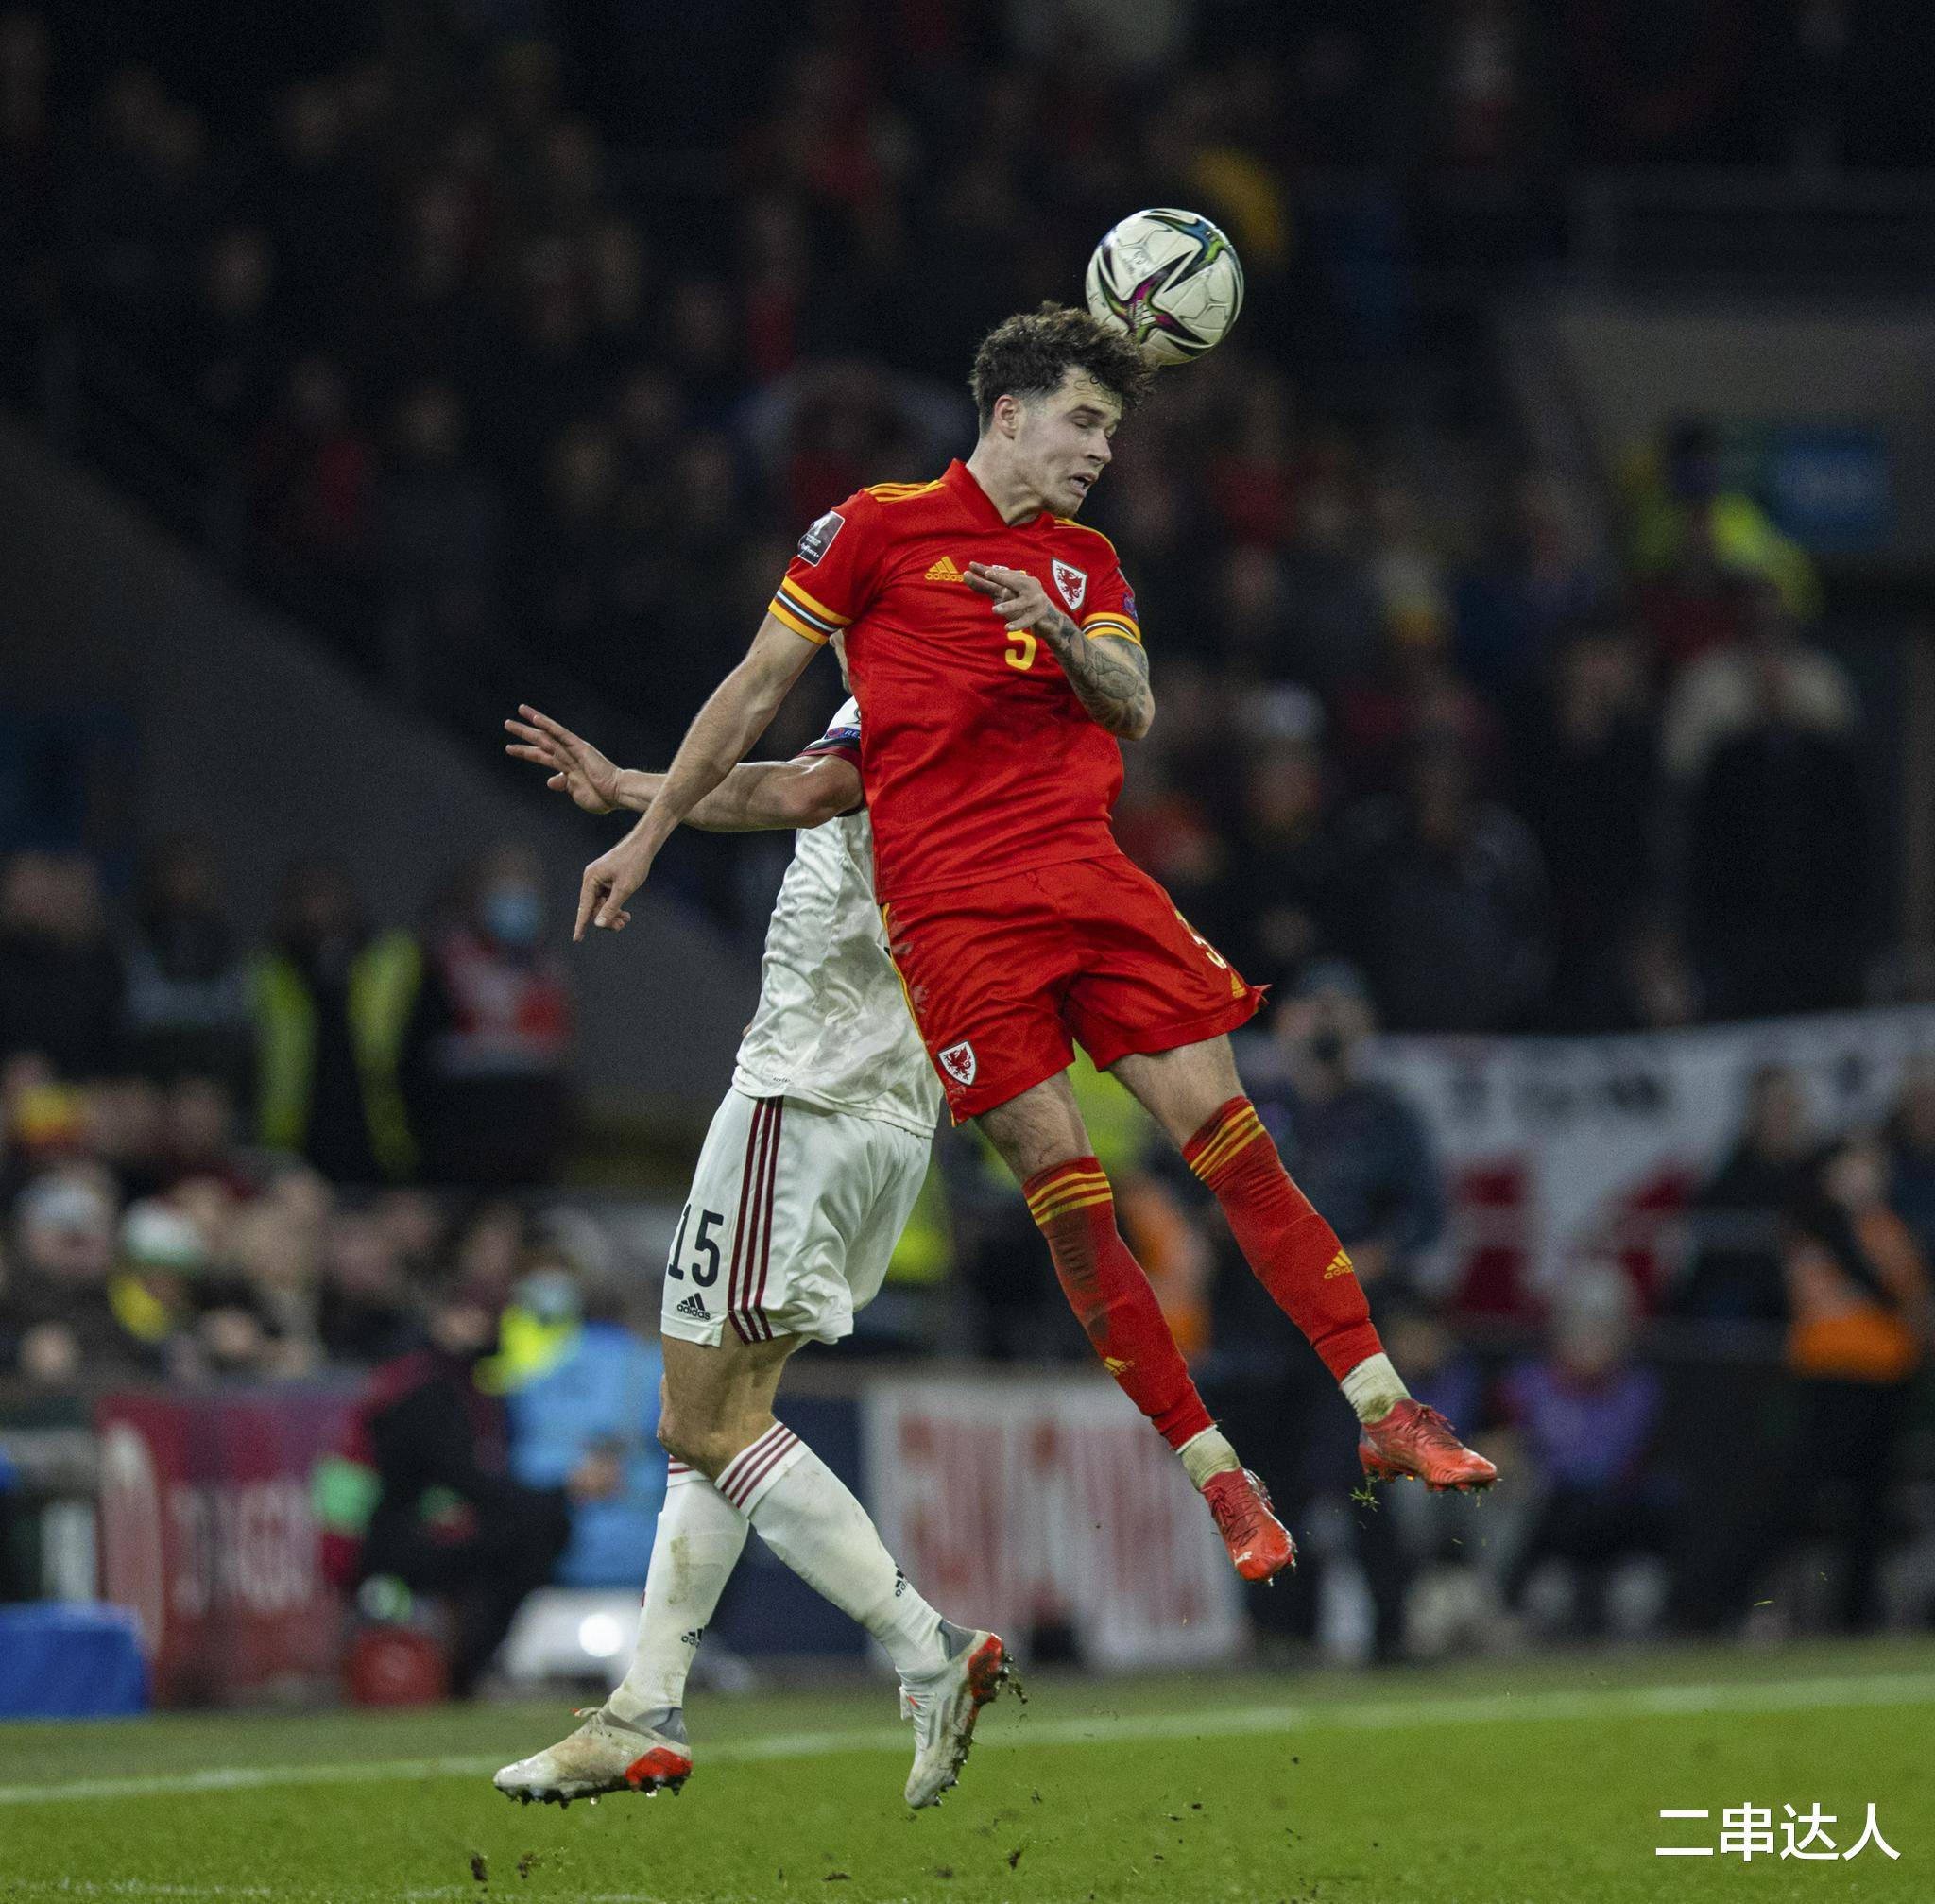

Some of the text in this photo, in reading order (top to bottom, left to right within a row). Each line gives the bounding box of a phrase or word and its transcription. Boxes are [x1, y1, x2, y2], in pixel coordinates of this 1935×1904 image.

[925, 570, 964, 583] adidas
[668, 1203, 725, 1288] 15
[676, 1303, 711, 1320] adidas
